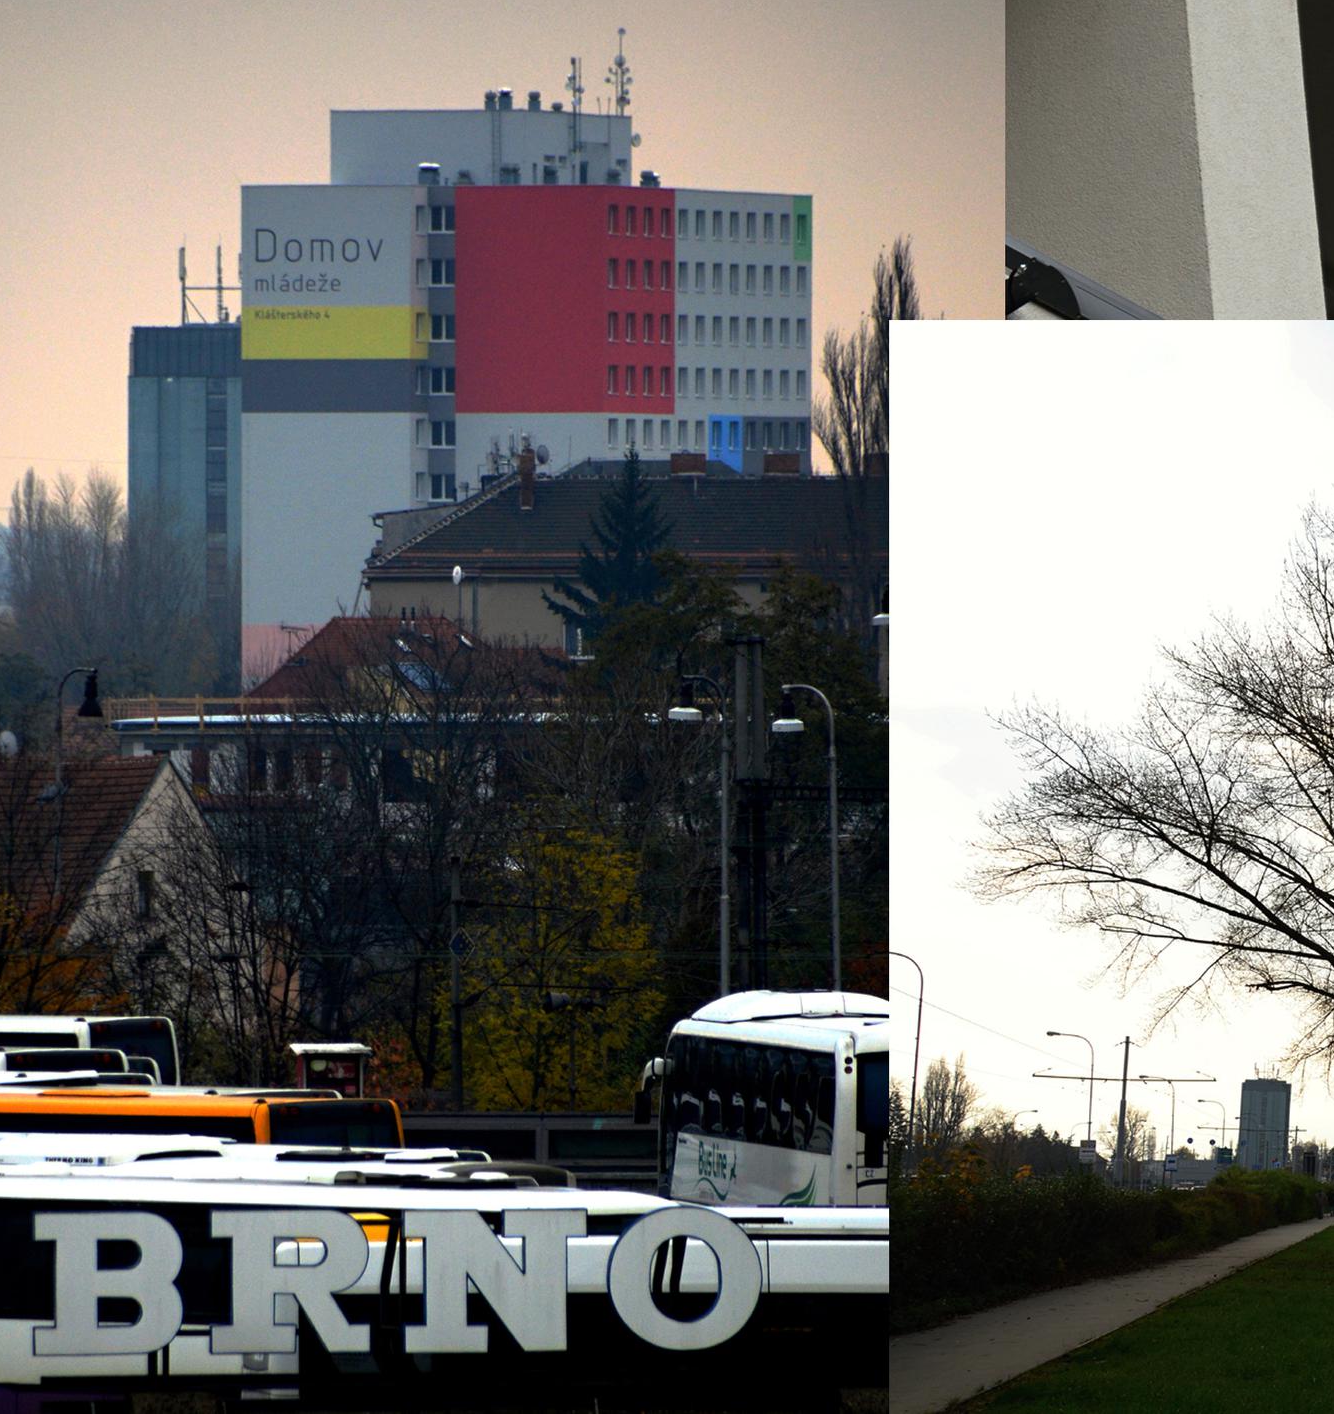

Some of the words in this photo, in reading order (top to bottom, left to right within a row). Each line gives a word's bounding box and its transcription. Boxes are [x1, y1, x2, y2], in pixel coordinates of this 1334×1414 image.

[254, 228, 384, 263] Domov
[254, 273, 342, 292] mládeže
[33, 1203, 763, 1356] BRNO
